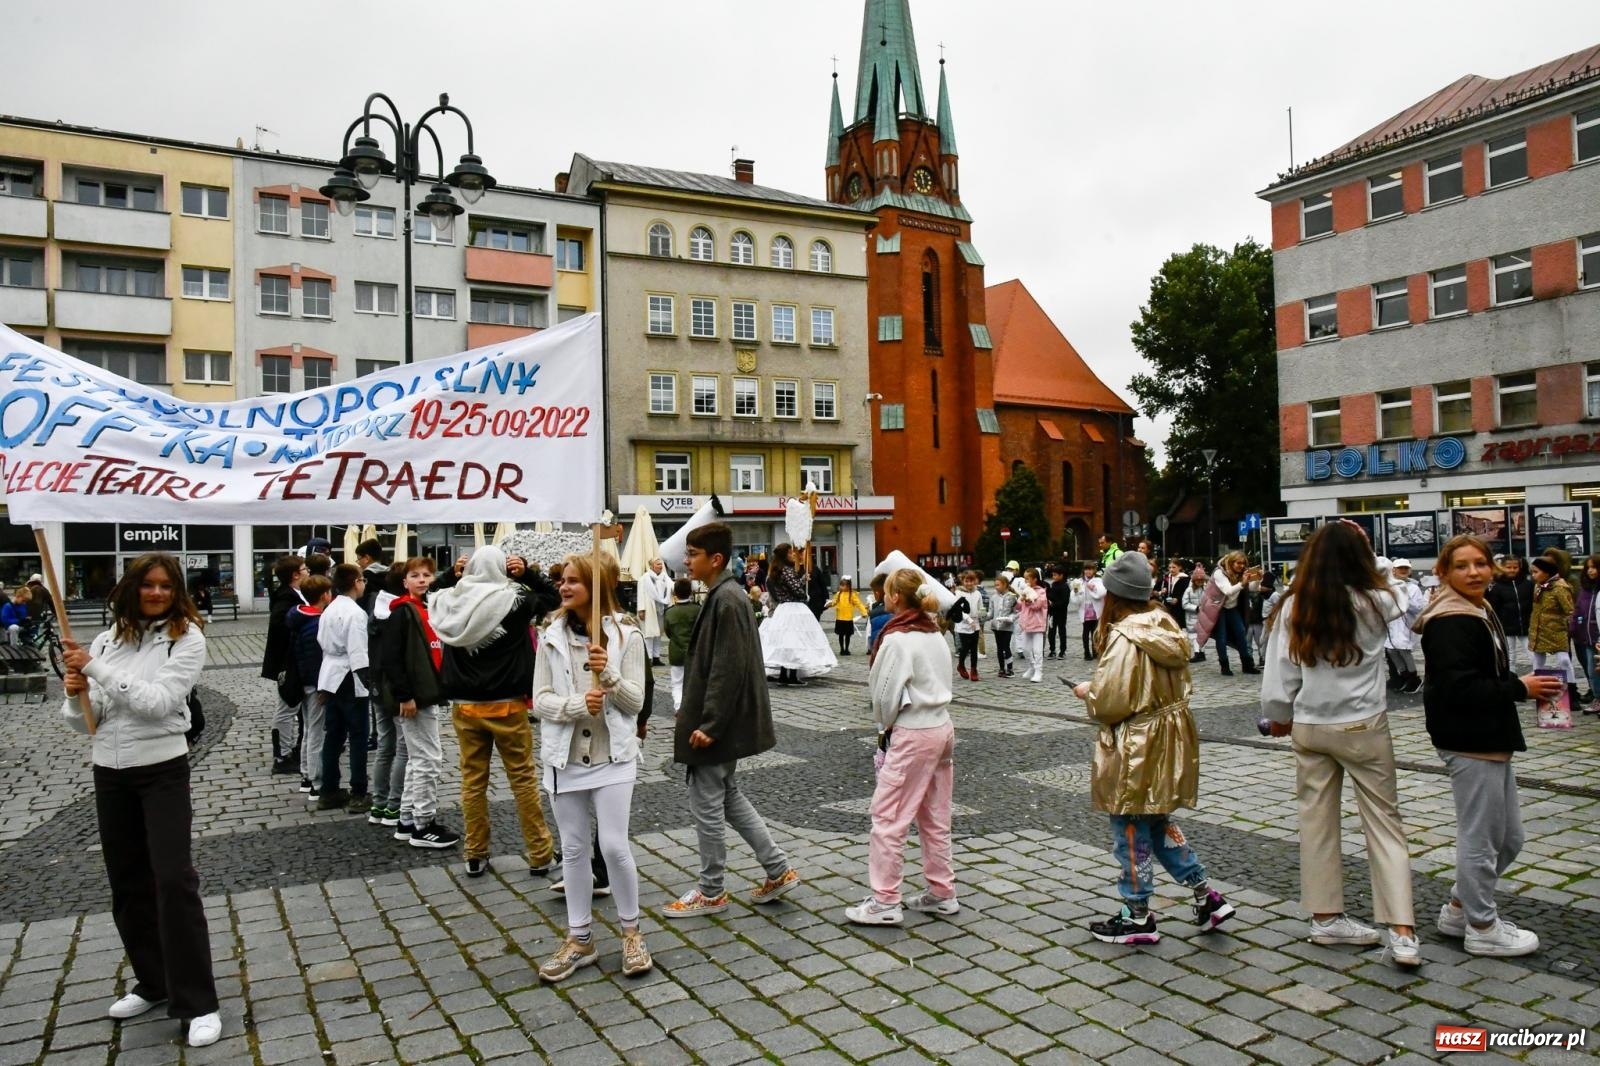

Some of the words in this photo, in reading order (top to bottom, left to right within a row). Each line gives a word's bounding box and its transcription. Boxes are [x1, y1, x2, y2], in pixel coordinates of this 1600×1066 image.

[1305, 436, 1466, 481] BOLKO
[83, 454, 226, 502] TEATRU
[253, 451, 529, 506] TETRAEDR
[675, 497, 693, 506] TEB
[123, 525, 179, 543] empik
